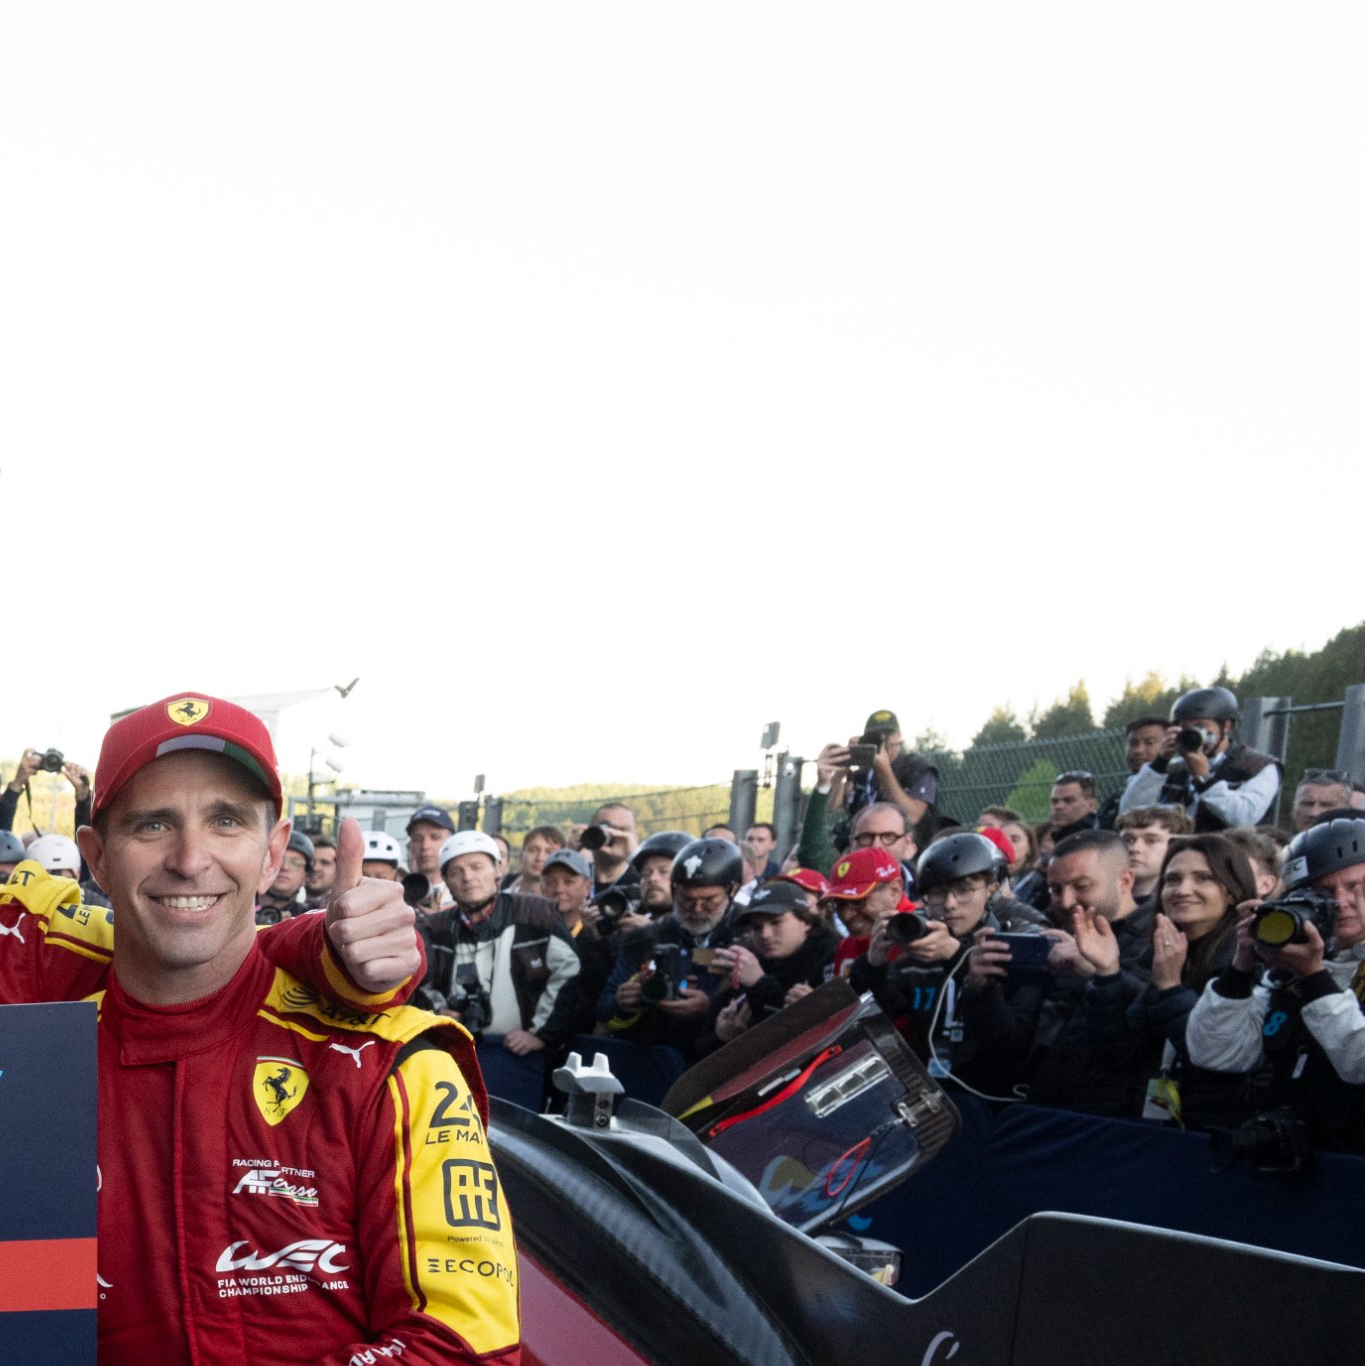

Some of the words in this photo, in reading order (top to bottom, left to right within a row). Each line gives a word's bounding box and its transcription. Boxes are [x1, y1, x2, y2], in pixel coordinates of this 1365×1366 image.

[425, 1130, 450, 1144] LE
[457, 1130, 483, 1144] MA
[232, 1158, 272, 1168] RACING
[274, 1160, 315, 1178] PRTNER
[232, 1169, 281, 1194] AF
[447, 1235, 482, 1243] Powered
[216, 1239, 350, 1274] WEC
[218, 1278, 236, 1288] FIA
[239, 1276, 283, 1287] WORLD
[220, 1284, 308, 1298] CHAMPIONSHIP
